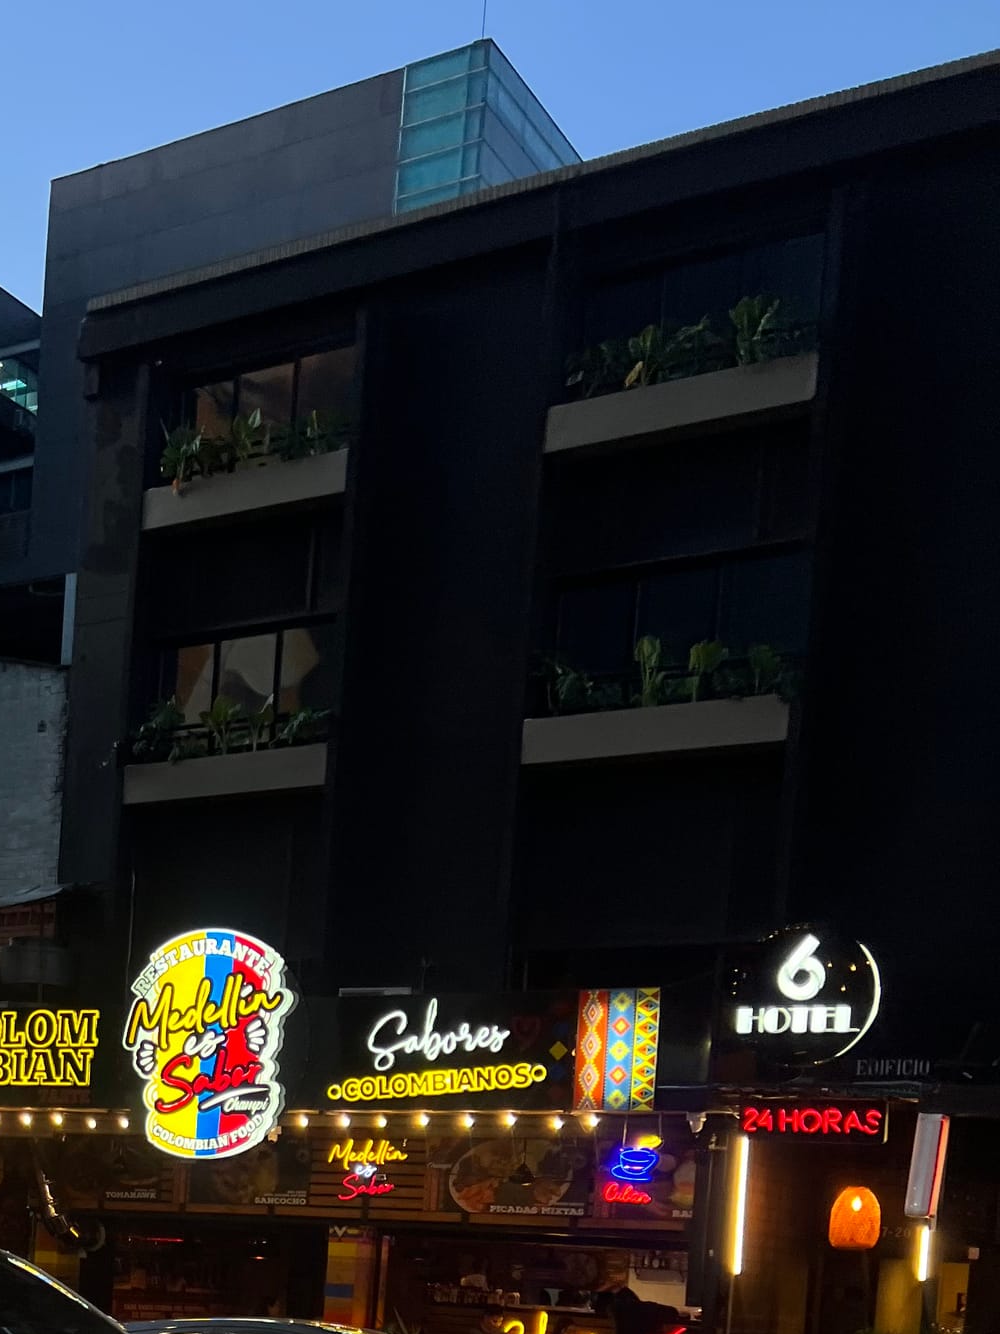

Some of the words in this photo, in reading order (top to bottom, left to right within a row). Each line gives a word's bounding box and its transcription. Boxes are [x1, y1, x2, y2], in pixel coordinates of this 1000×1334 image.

[133, 938, 275, 996] RESTAURANTE
[776, 933, 826, 1001] 6
[126, 971, 284, 1052] Medellín
[735, 1004, 861, 1034] HOTEL
[183, 1030, 227, 1060] es
[367, 998, 511, 1072] Sabores
[154, 1047, 265, 1116] Sabor
[340, 1062, 533, 1102] COLOMBIANOS
[856, 1059, 931, 1076] EDIFICIO
[223, 1096, 270, 1115] Champi
[743, 1107, 773, 1133] 24
[778, 1107, 883, 1135] HORAS
[152, 1123, 229, 1150] COLOMBIAN
[230, 1114, 264, 1144] FOOD
[489, 1205, 538, 1215] PICADAS
